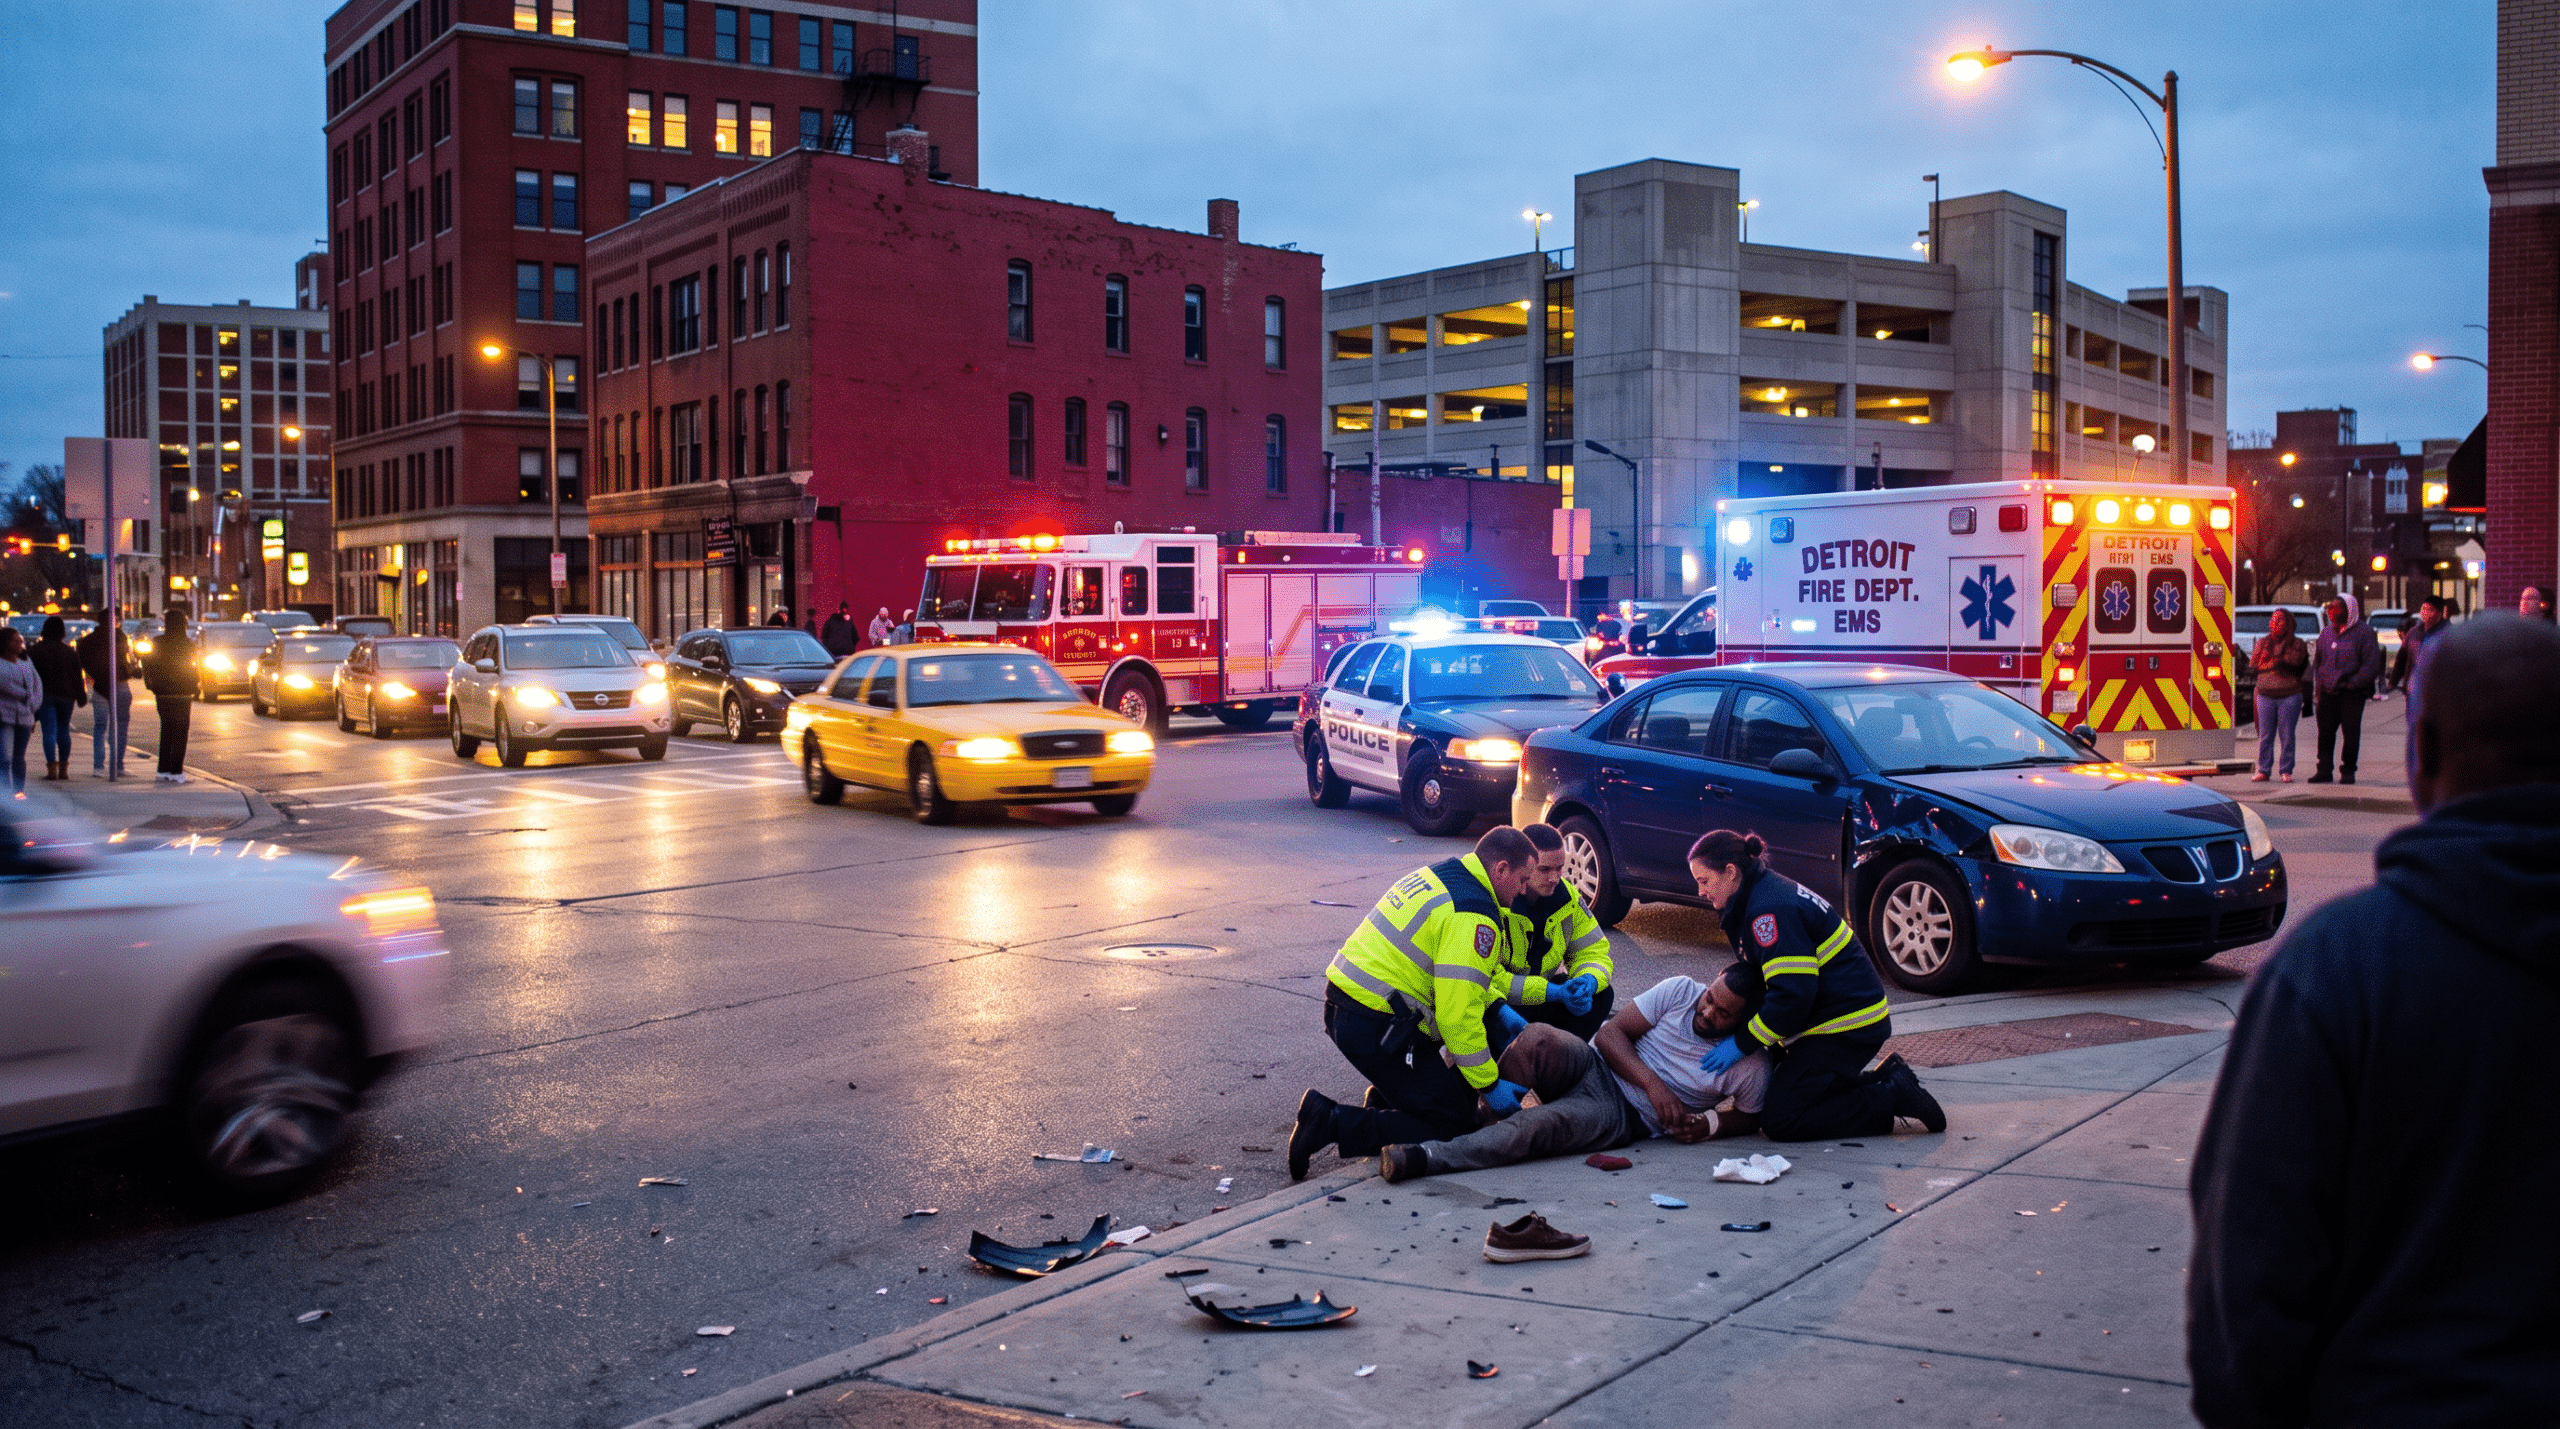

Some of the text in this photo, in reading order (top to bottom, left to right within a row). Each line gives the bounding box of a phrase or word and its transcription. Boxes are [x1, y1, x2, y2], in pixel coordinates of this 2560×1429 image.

[2103, 536, 2180, 550] DETROIT
[1802, 539, 1915, 574] DETROIT
[2150, 553, 2174, 565] EMS
[1799, 578, 1919, 603] FIRE DEPT.
[1834, 609, 1881, 633] EMS
[1329, 722, 1389, 752] POLICE
